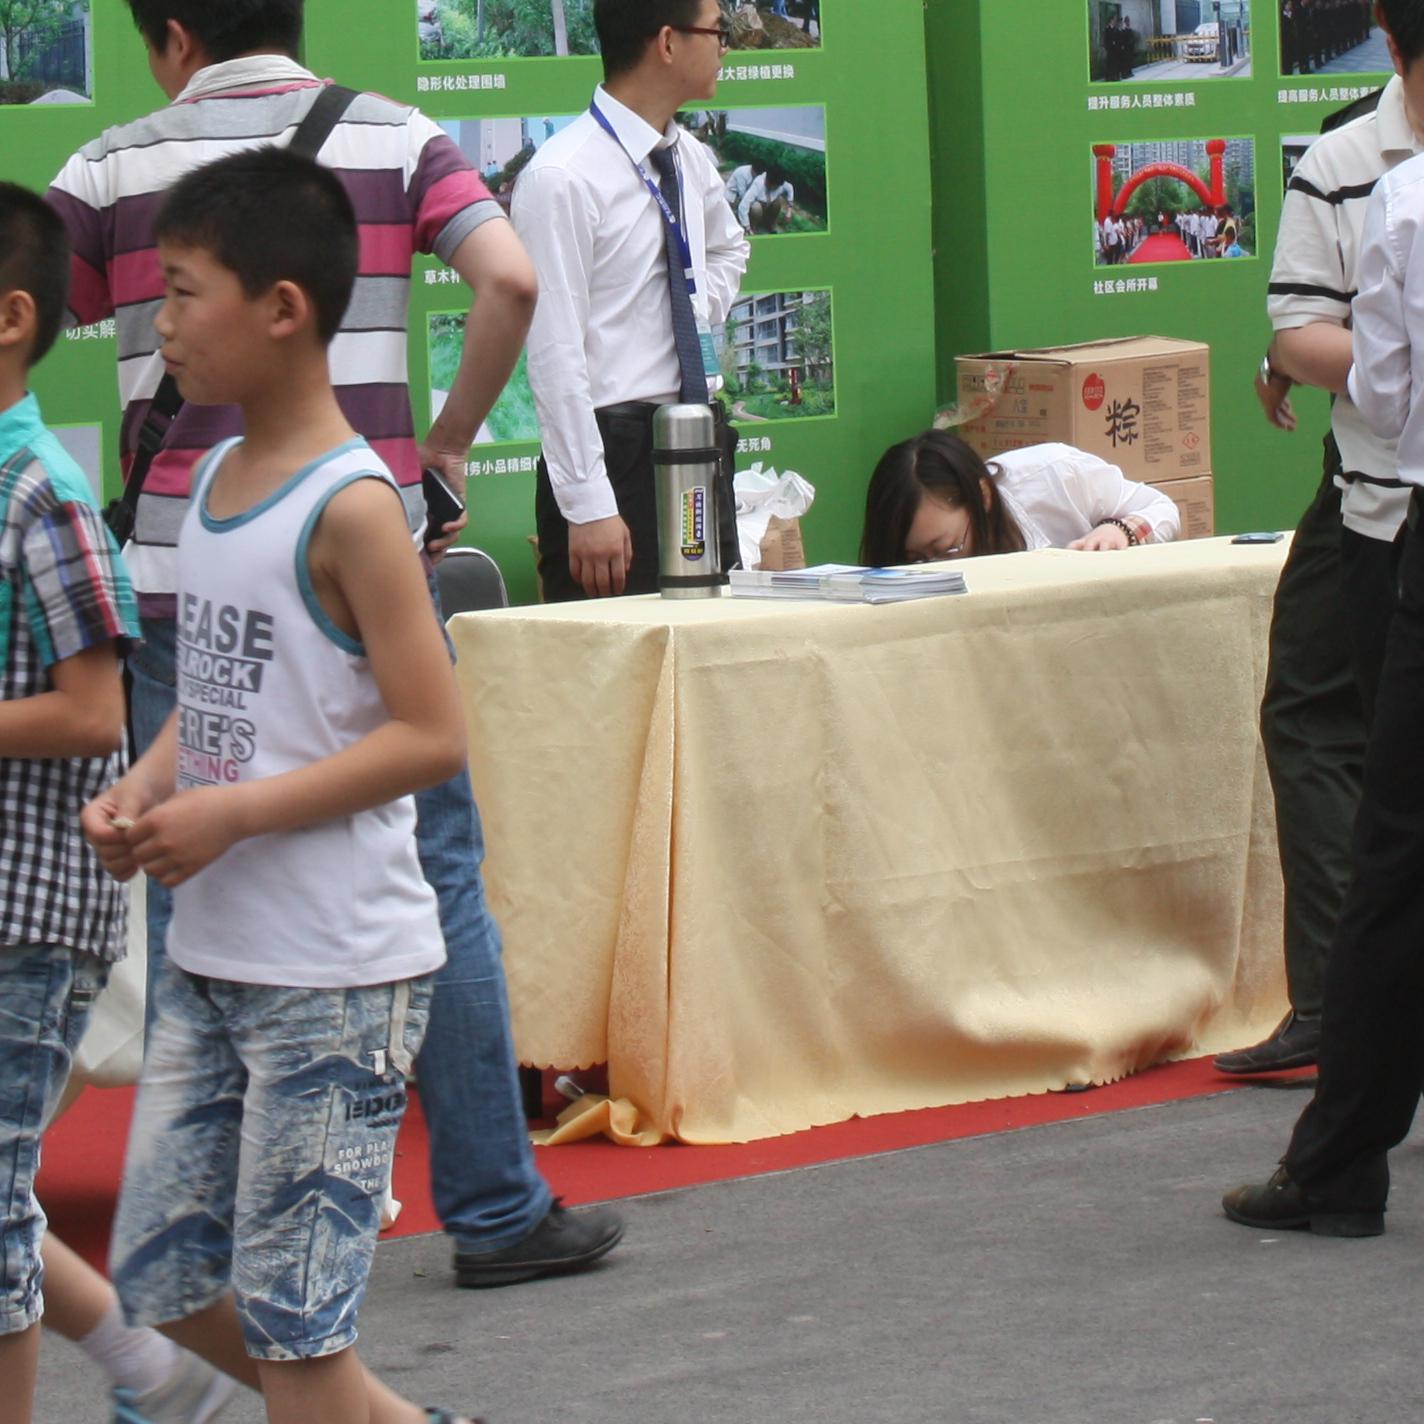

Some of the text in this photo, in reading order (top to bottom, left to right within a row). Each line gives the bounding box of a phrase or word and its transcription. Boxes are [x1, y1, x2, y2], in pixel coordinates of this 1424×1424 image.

[416, 73, 506, 92] 隐形化处理围墙
[179, 591, 274, 662] EASE
